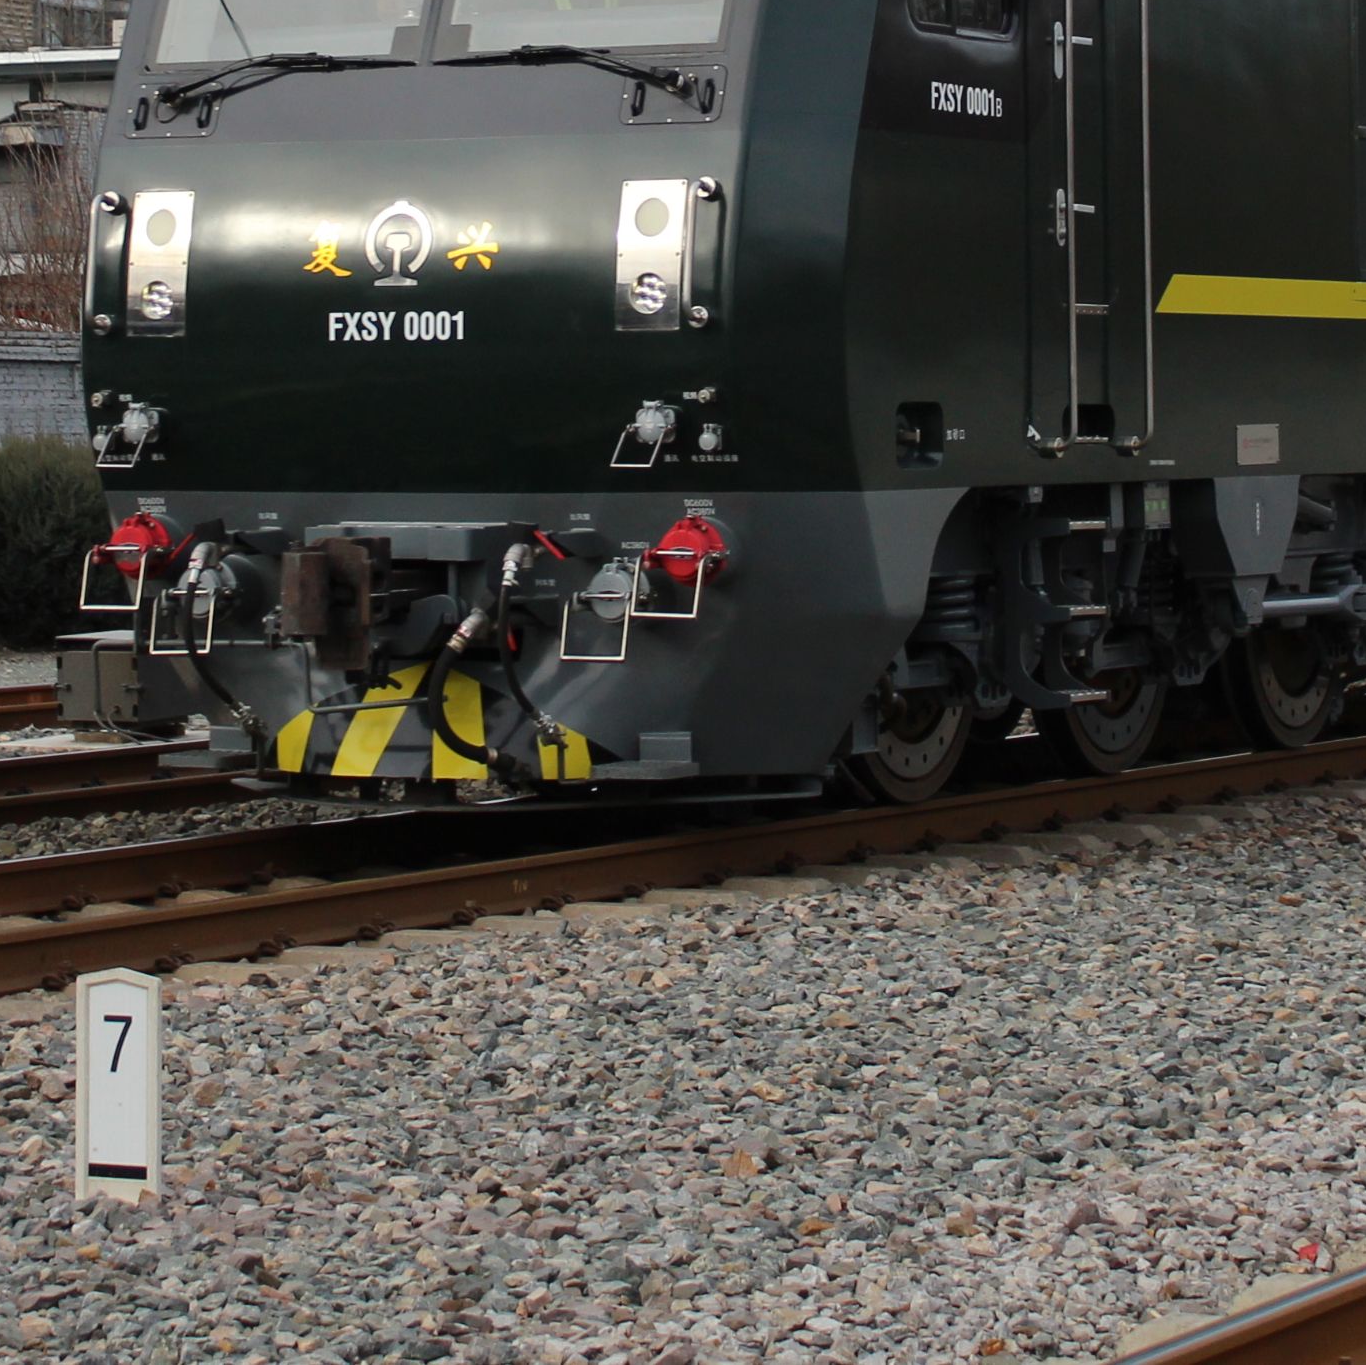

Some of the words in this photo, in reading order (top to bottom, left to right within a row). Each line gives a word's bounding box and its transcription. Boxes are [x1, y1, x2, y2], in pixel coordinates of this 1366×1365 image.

[931, 81, 964, 113] FXSY
[303, 219, 353, 278] 复
[446, 221, 499, 271] 兴
[329, 311, 396, 341] FXSY
[403, 310, 465, 341] 0001
[103, 1014, 133, 1073] 7
